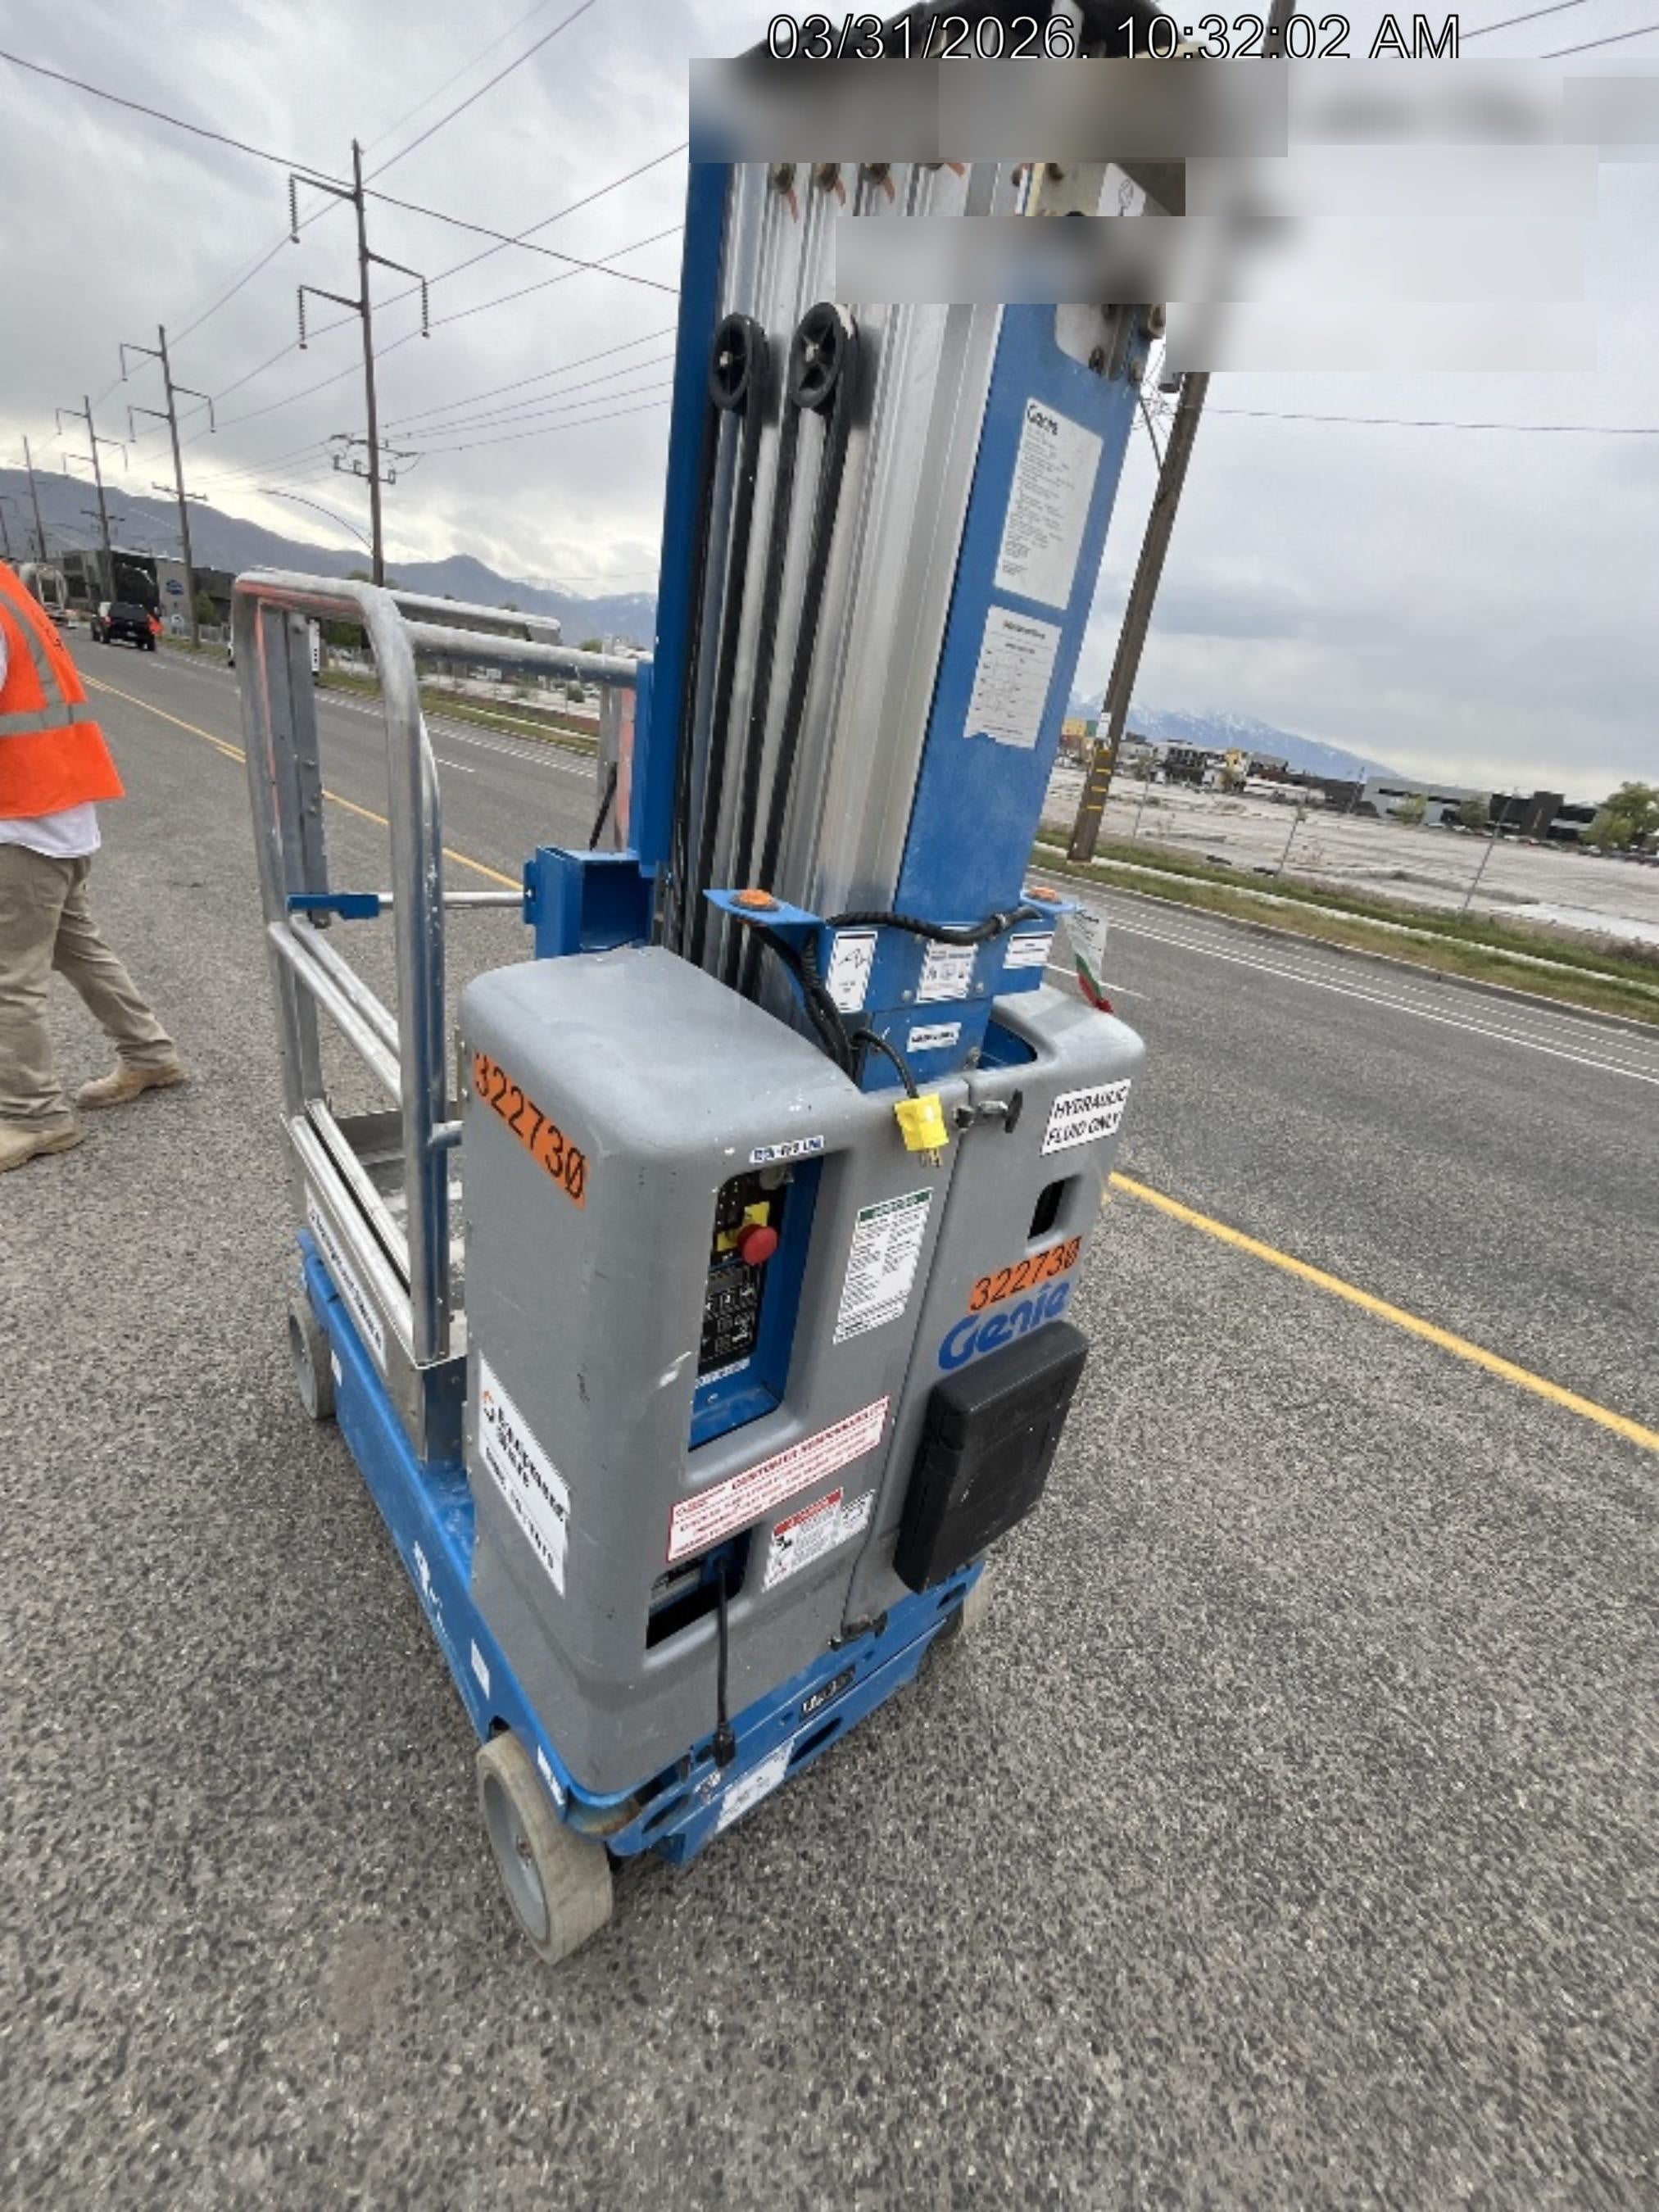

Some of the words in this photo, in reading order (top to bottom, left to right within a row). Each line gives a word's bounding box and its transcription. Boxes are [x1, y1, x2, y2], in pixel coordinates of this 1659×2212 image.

[475, 1052, 586, 1199] 322730
[969, 1235, 1082, 1312] 322730
[937, 1281, 1071, 1371] Genie
